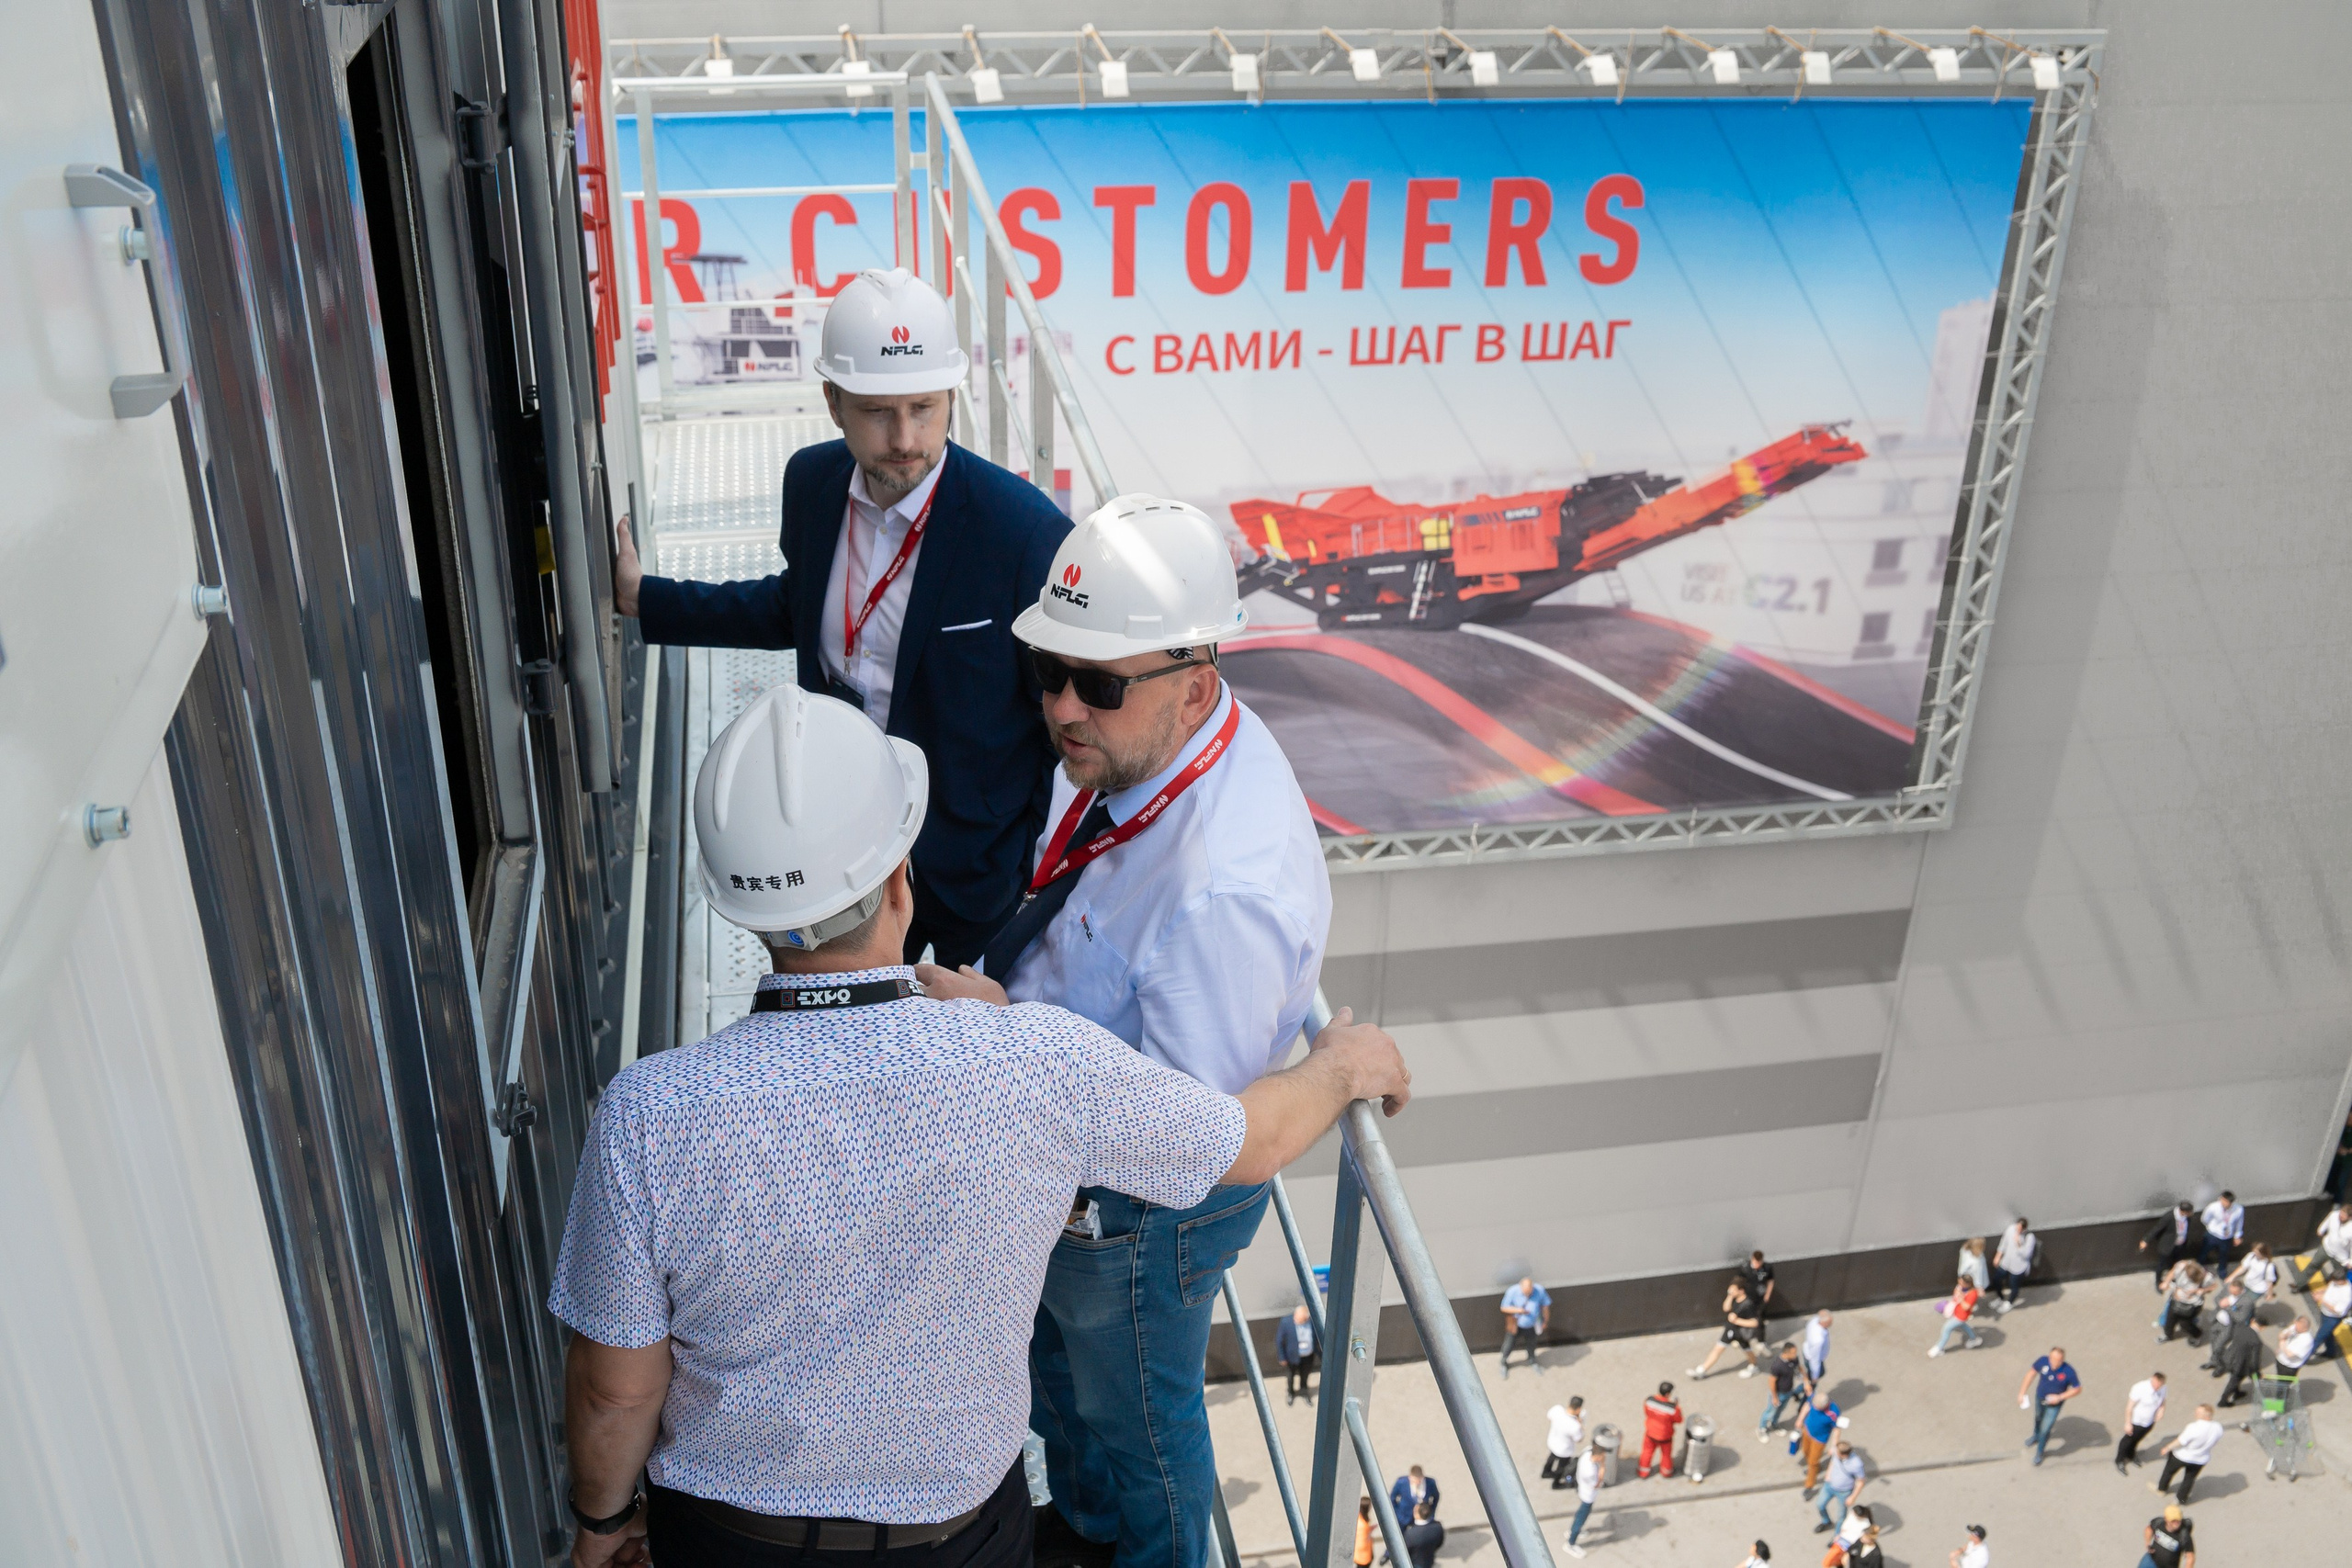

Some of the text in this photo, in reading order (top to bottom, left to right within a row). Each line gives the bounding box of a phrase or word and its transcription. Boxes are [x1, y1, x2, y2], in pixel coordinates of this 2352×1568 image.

[789, 173, 1645, 308] CSTOMERS
[881, 344, 923, 356] NFLG
[1153, 329, 1303, 374] ВАМИ
[1349, 324, 1462, 367] ШАГ
[1475, 324, 1506, 363] В
[1521, 320, 1632, 362] ШАГ
[1050, 582, 1090, 609] NFLG
[729, 869, 806, 892] 贵宾专用
[797, 988, 851, 1006] EXPO
